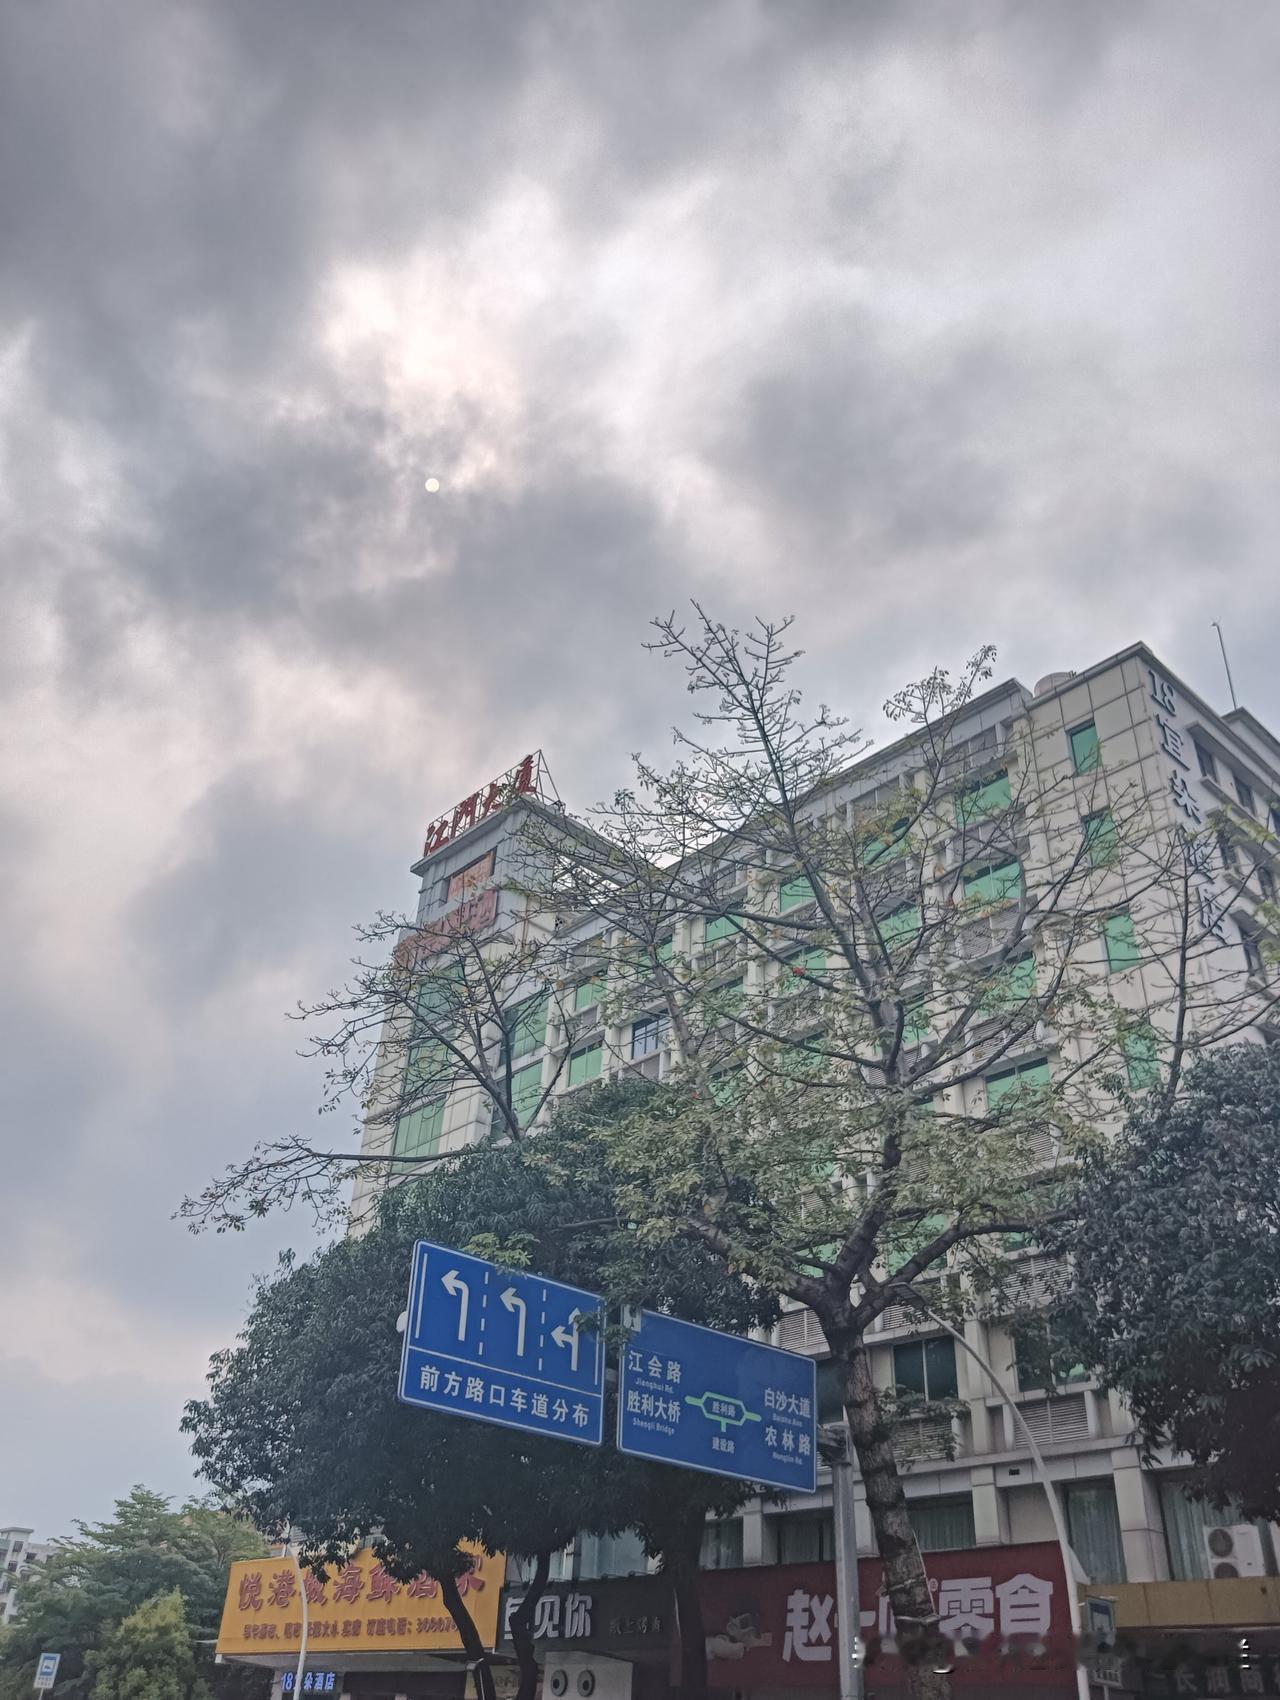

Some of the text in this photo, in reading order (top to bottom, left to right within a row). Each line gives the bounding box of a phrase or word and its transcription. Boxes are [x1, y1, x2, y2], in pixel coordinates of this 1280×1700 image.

[628, 1350, 681, 1384] 江会路
[420, 1364, 590, 1427] 前方路口车道分布
[627, 1390, 681, 1424] 胜利大桥
[711, 1400, 736, 1418] 胜利路
[764, 1387, 811, 1419] 白沙大道
[765, 1425, 811, 1456] 农林路
[782, 1573, 1053, 1661] 赵一零食
[280, 1671, 336, 1692] 18朵酒店
